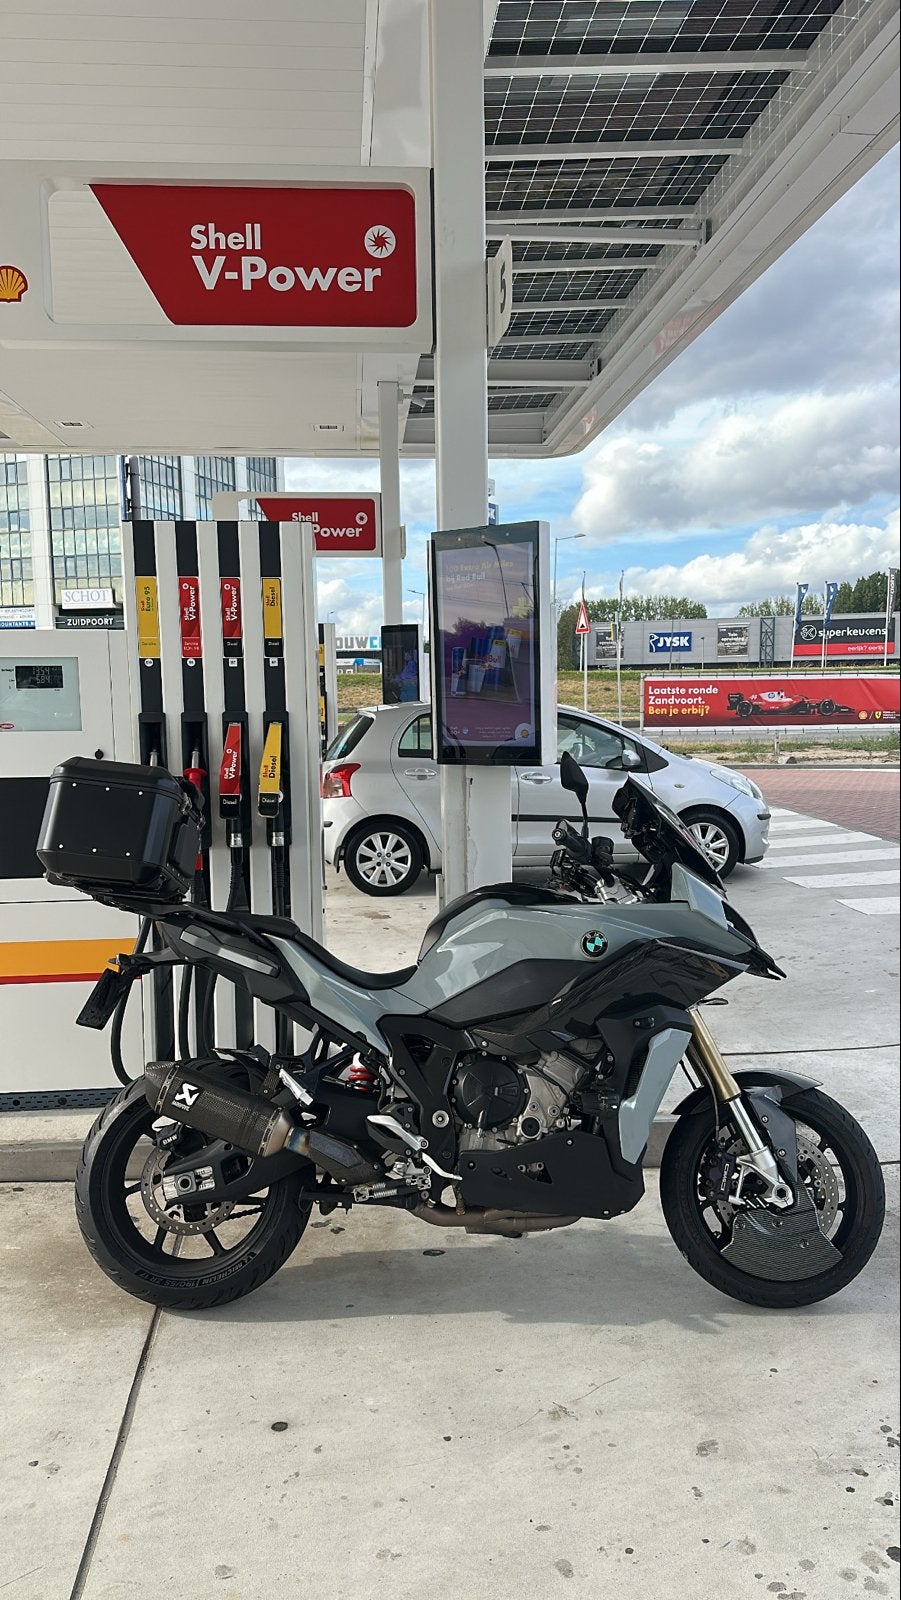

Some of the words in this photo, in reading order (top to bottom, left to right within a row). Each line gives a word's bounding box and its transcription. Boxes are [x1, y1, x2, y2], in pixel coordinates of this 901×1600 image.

[190, 223, 262, 250] Shell
[191, 256, 383, 293] V-Power
[500, 261, 507, 314] 5
[292, 512, 319, 522] Shell
[65, 590, 109, 603] SCHOT
[144, 586, 151, 595] 95
[230, 587, 238, 621] V-Power
[67, 618, 114, 626] ZUIDPOORT
[336, 637, 381, 649] OUWC
[657, 636, 690, 647] JYSK
[649, 686, 686, 695] Laatste
[688, 685, 719, 694] ronde
[648, 696, 706, 705] Zandvoort.
[648, 706, 668, 714] Ben
[669, 706, 679, 717] je
[681, 706, 711, 716] erbij?
[229, 751, 238, 779] V-Power
[269, 755, 277, 779] Diesel
[162, 1134, 178, 1146] BMW
[202, 1262, 243, 1285] MICHELIN
